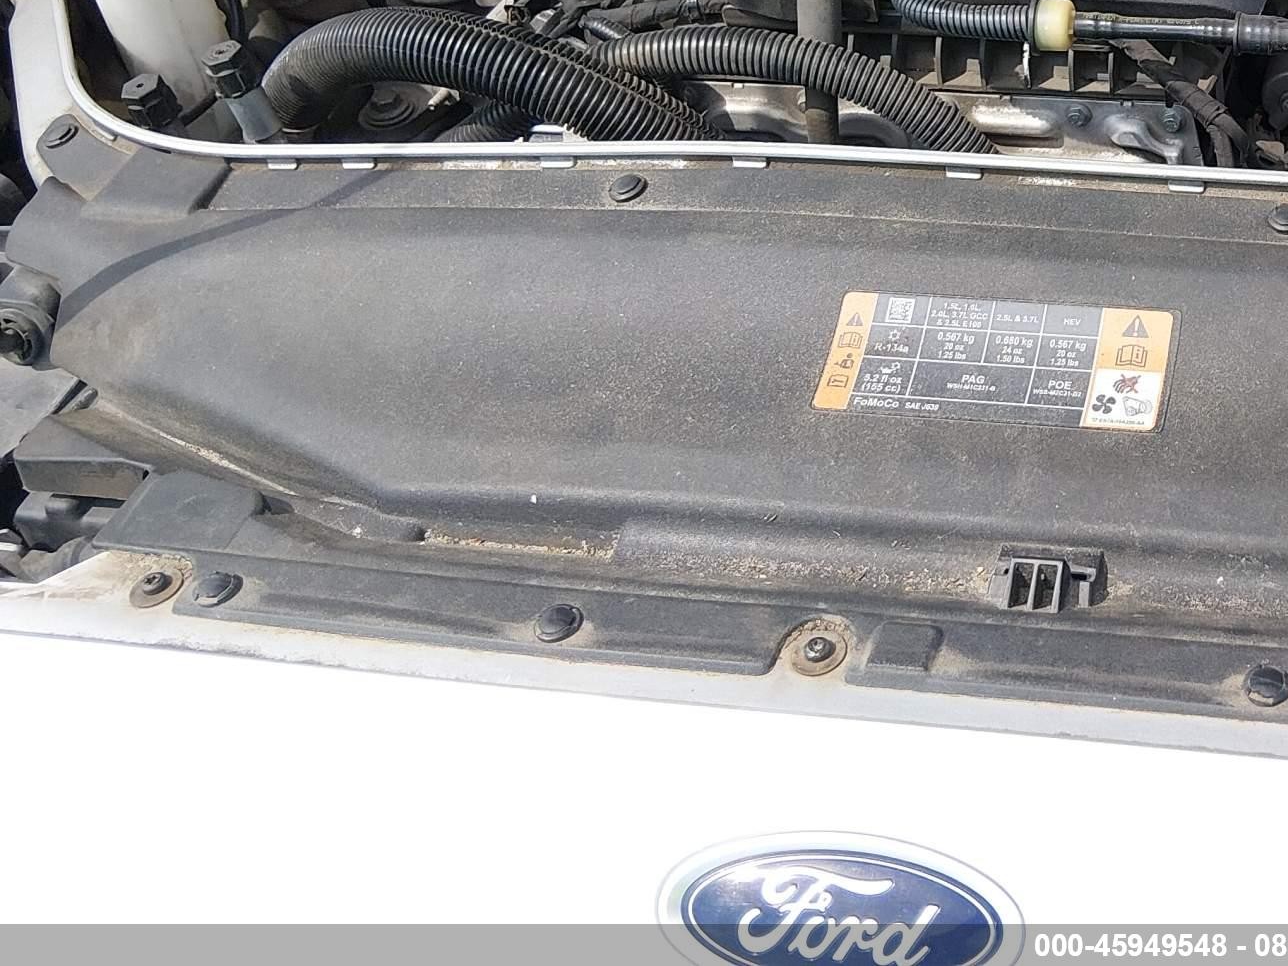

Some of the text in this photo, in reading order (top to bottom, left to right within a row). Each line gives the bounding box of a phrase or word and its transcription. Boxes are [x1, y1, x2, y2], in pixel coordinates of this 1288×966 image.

[1063, 317, 1081, 326] HEV
[962, 333, 975, 344] kg
[1021, 336, 1034, 348] kg
[873, 342, 909, 354] R-134a
[1001, 346, 1011, 355] 24
[1074, 340, 1087, 352] kg
[955, 351, 967, 360] lbs
[1013, 355, 1025, 364] lbs
[1068, 358, 1079, 367] lbs
[891, 376, 903, 384] oz
[960, 374, 986, 385] PAG
[1048, 379, 1073, 390] POE
[884, 384, 901, 395] cc)
[853, 396, 900, 409] FoMoCo
[904, 400, 921, 410] SAE
[737, 865, 941, 966] Ford
